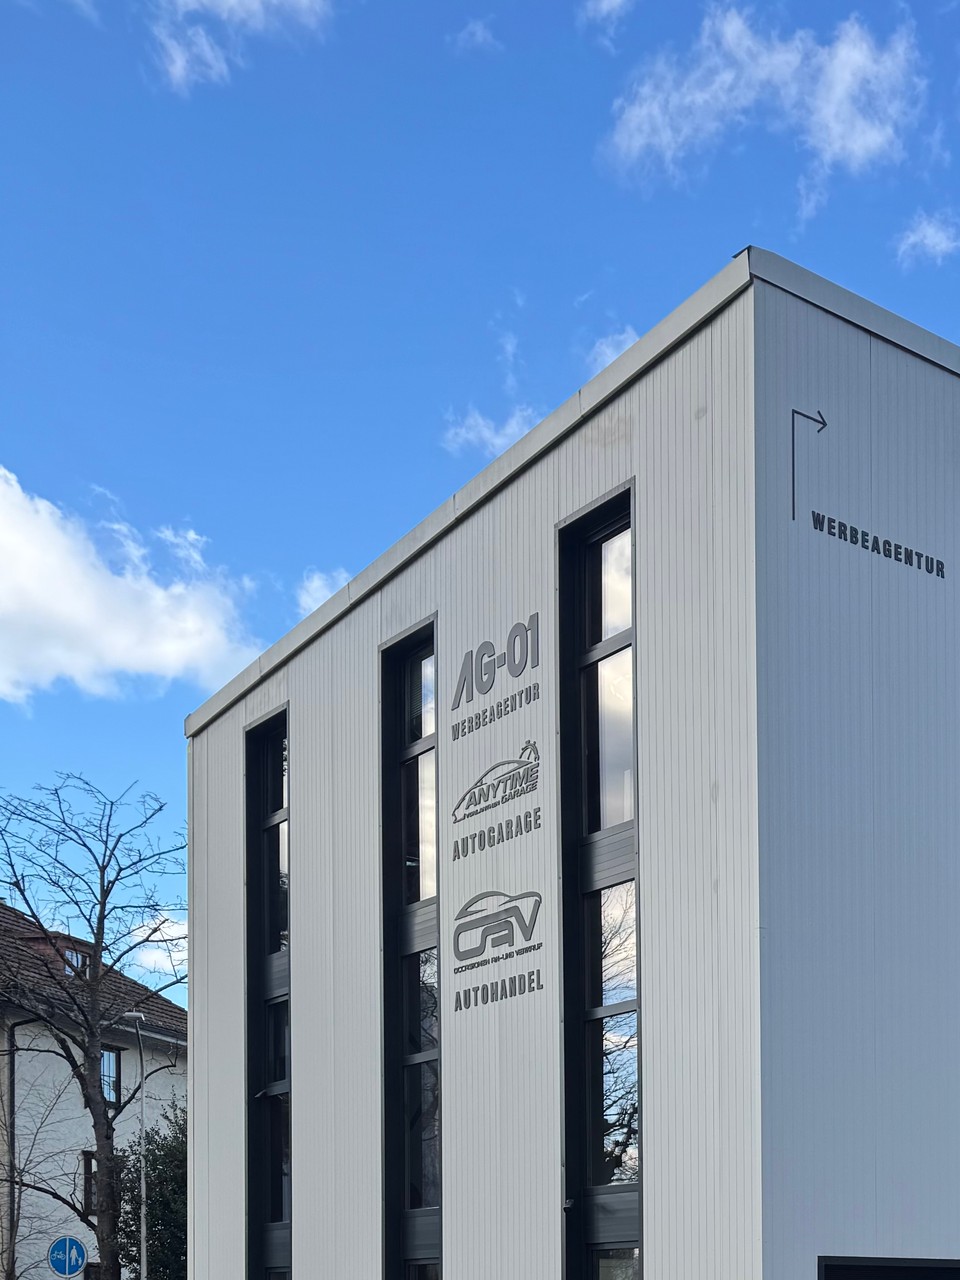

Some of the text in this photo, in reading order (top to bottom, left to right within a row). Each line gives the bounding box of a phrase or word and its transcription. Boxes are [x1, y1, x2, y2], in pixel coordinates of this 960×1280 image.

[811, 510, 945, 579] WERBEAGENTUR
[451, 612, 539, 711] AG-01
[451, 683, 540, 741] WERBEAGENTUR
[465, 762, 540, 810] ANYTIME
[501, 780, 538, 805] GARAGE
[452, 807, 541, 861] AUTOGARAGE
[454, 969, 544, 1012] AUTOHANDEL
